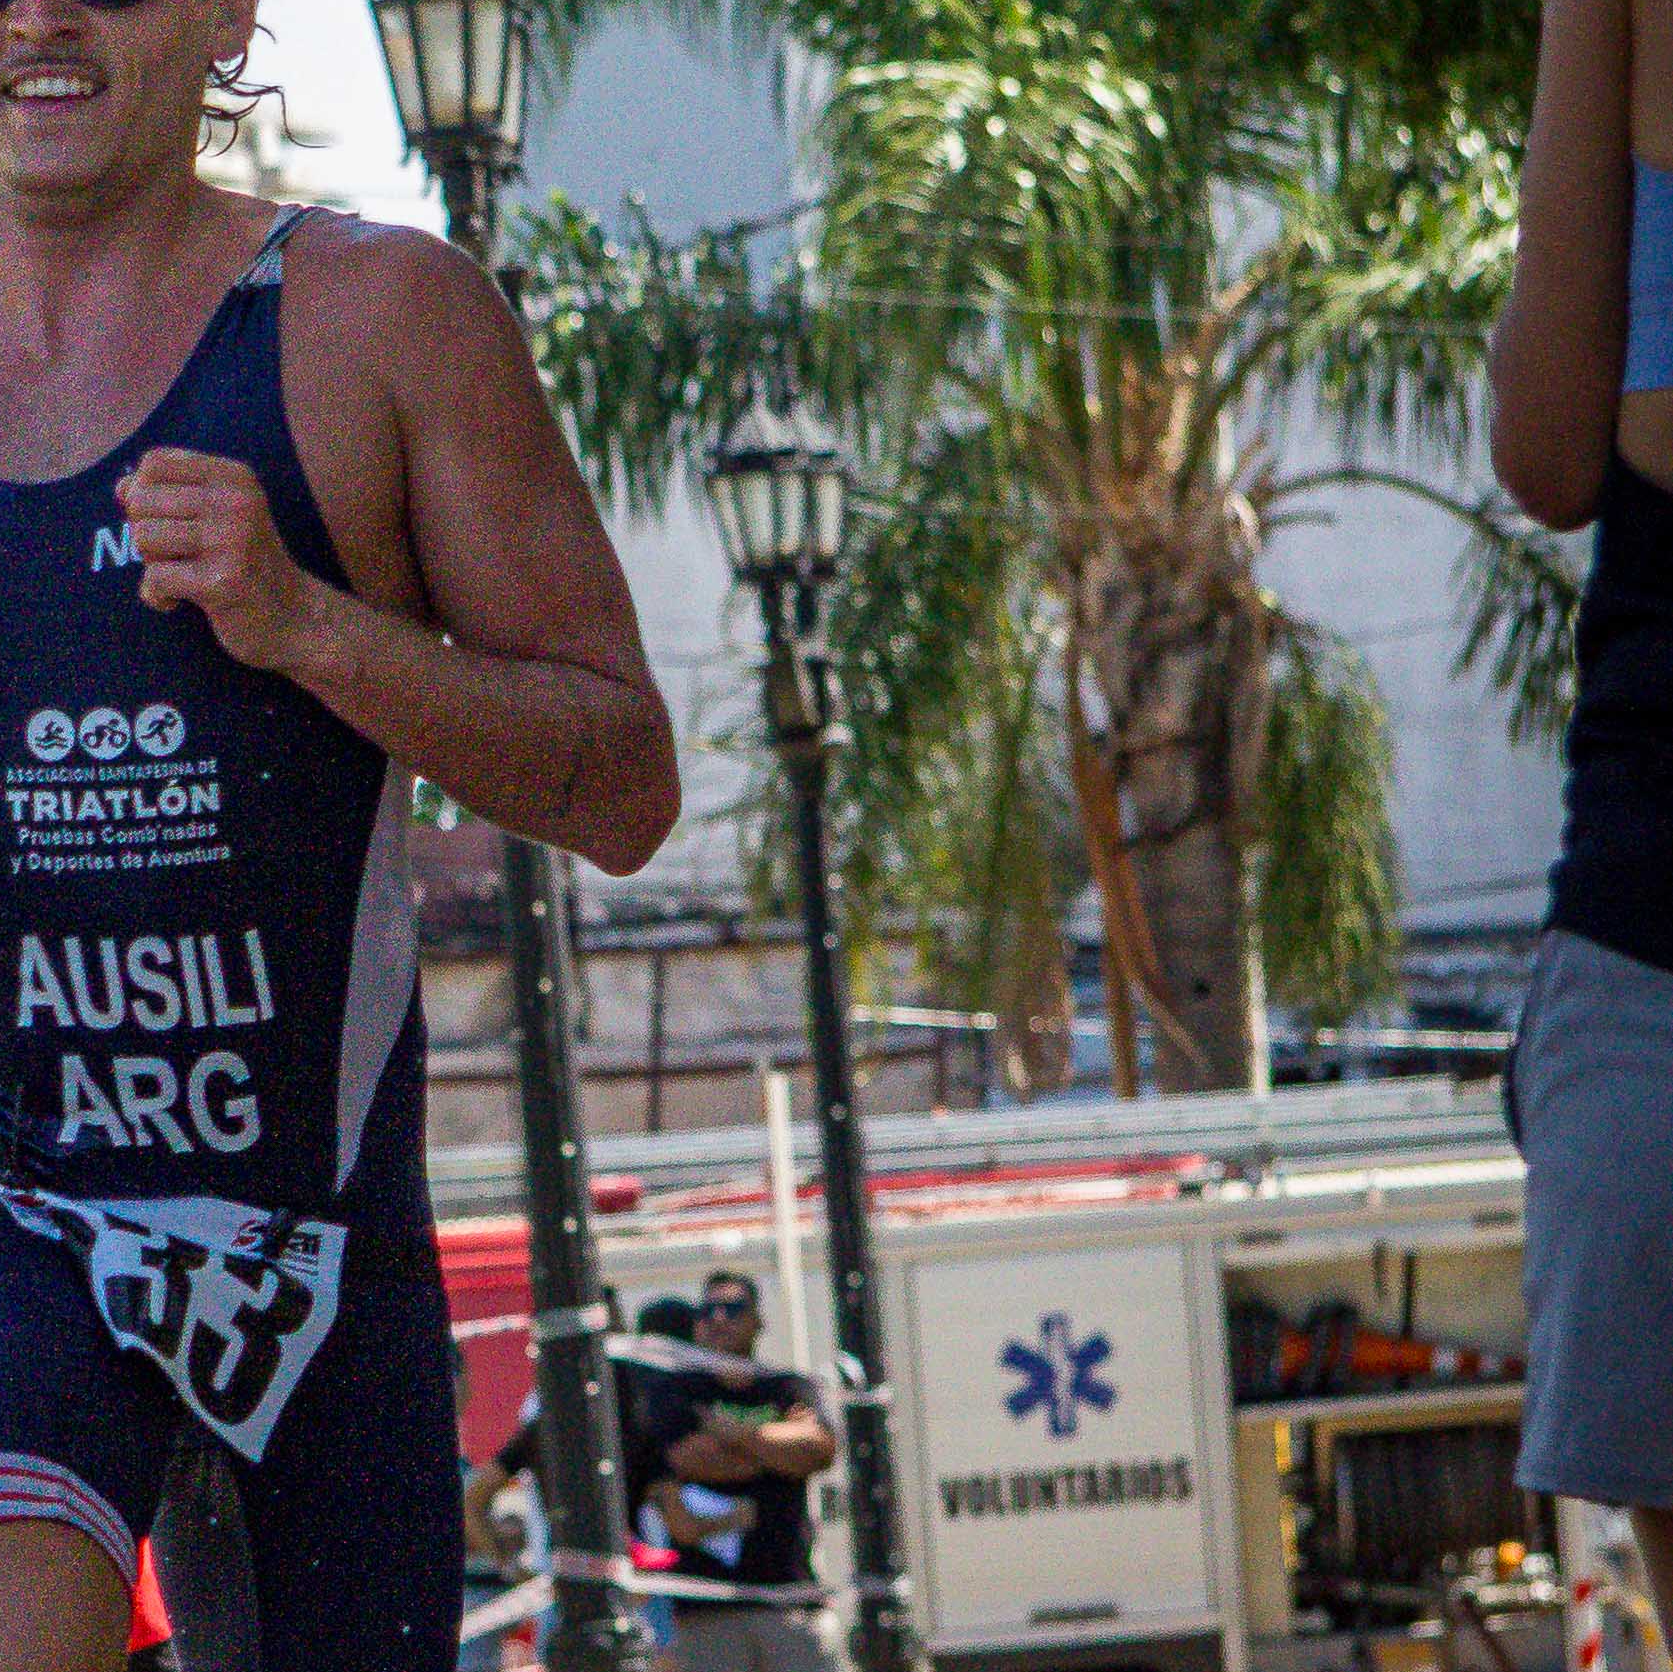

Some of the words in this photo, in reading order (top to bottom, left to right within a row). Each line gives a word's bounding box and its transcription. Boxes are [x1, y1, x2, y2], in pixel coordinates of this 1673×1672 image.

[197, 757, 218, 775] DE
[6, 778, 221, 822] TRIATLÓN
[16, 825, 96, 845] Pruebas
[9, 853, 24, 875] y
[26, 852, 116, 875] Deportes
[118, 853, 145, 870] de
[146, 845, 232, 868] Aventura
[17, 927, 274, 1031] AUSILI
[56, 1050, 261, 1154] ARG
[937, 1454, 1194, 1521] VOLUNTARIOS
